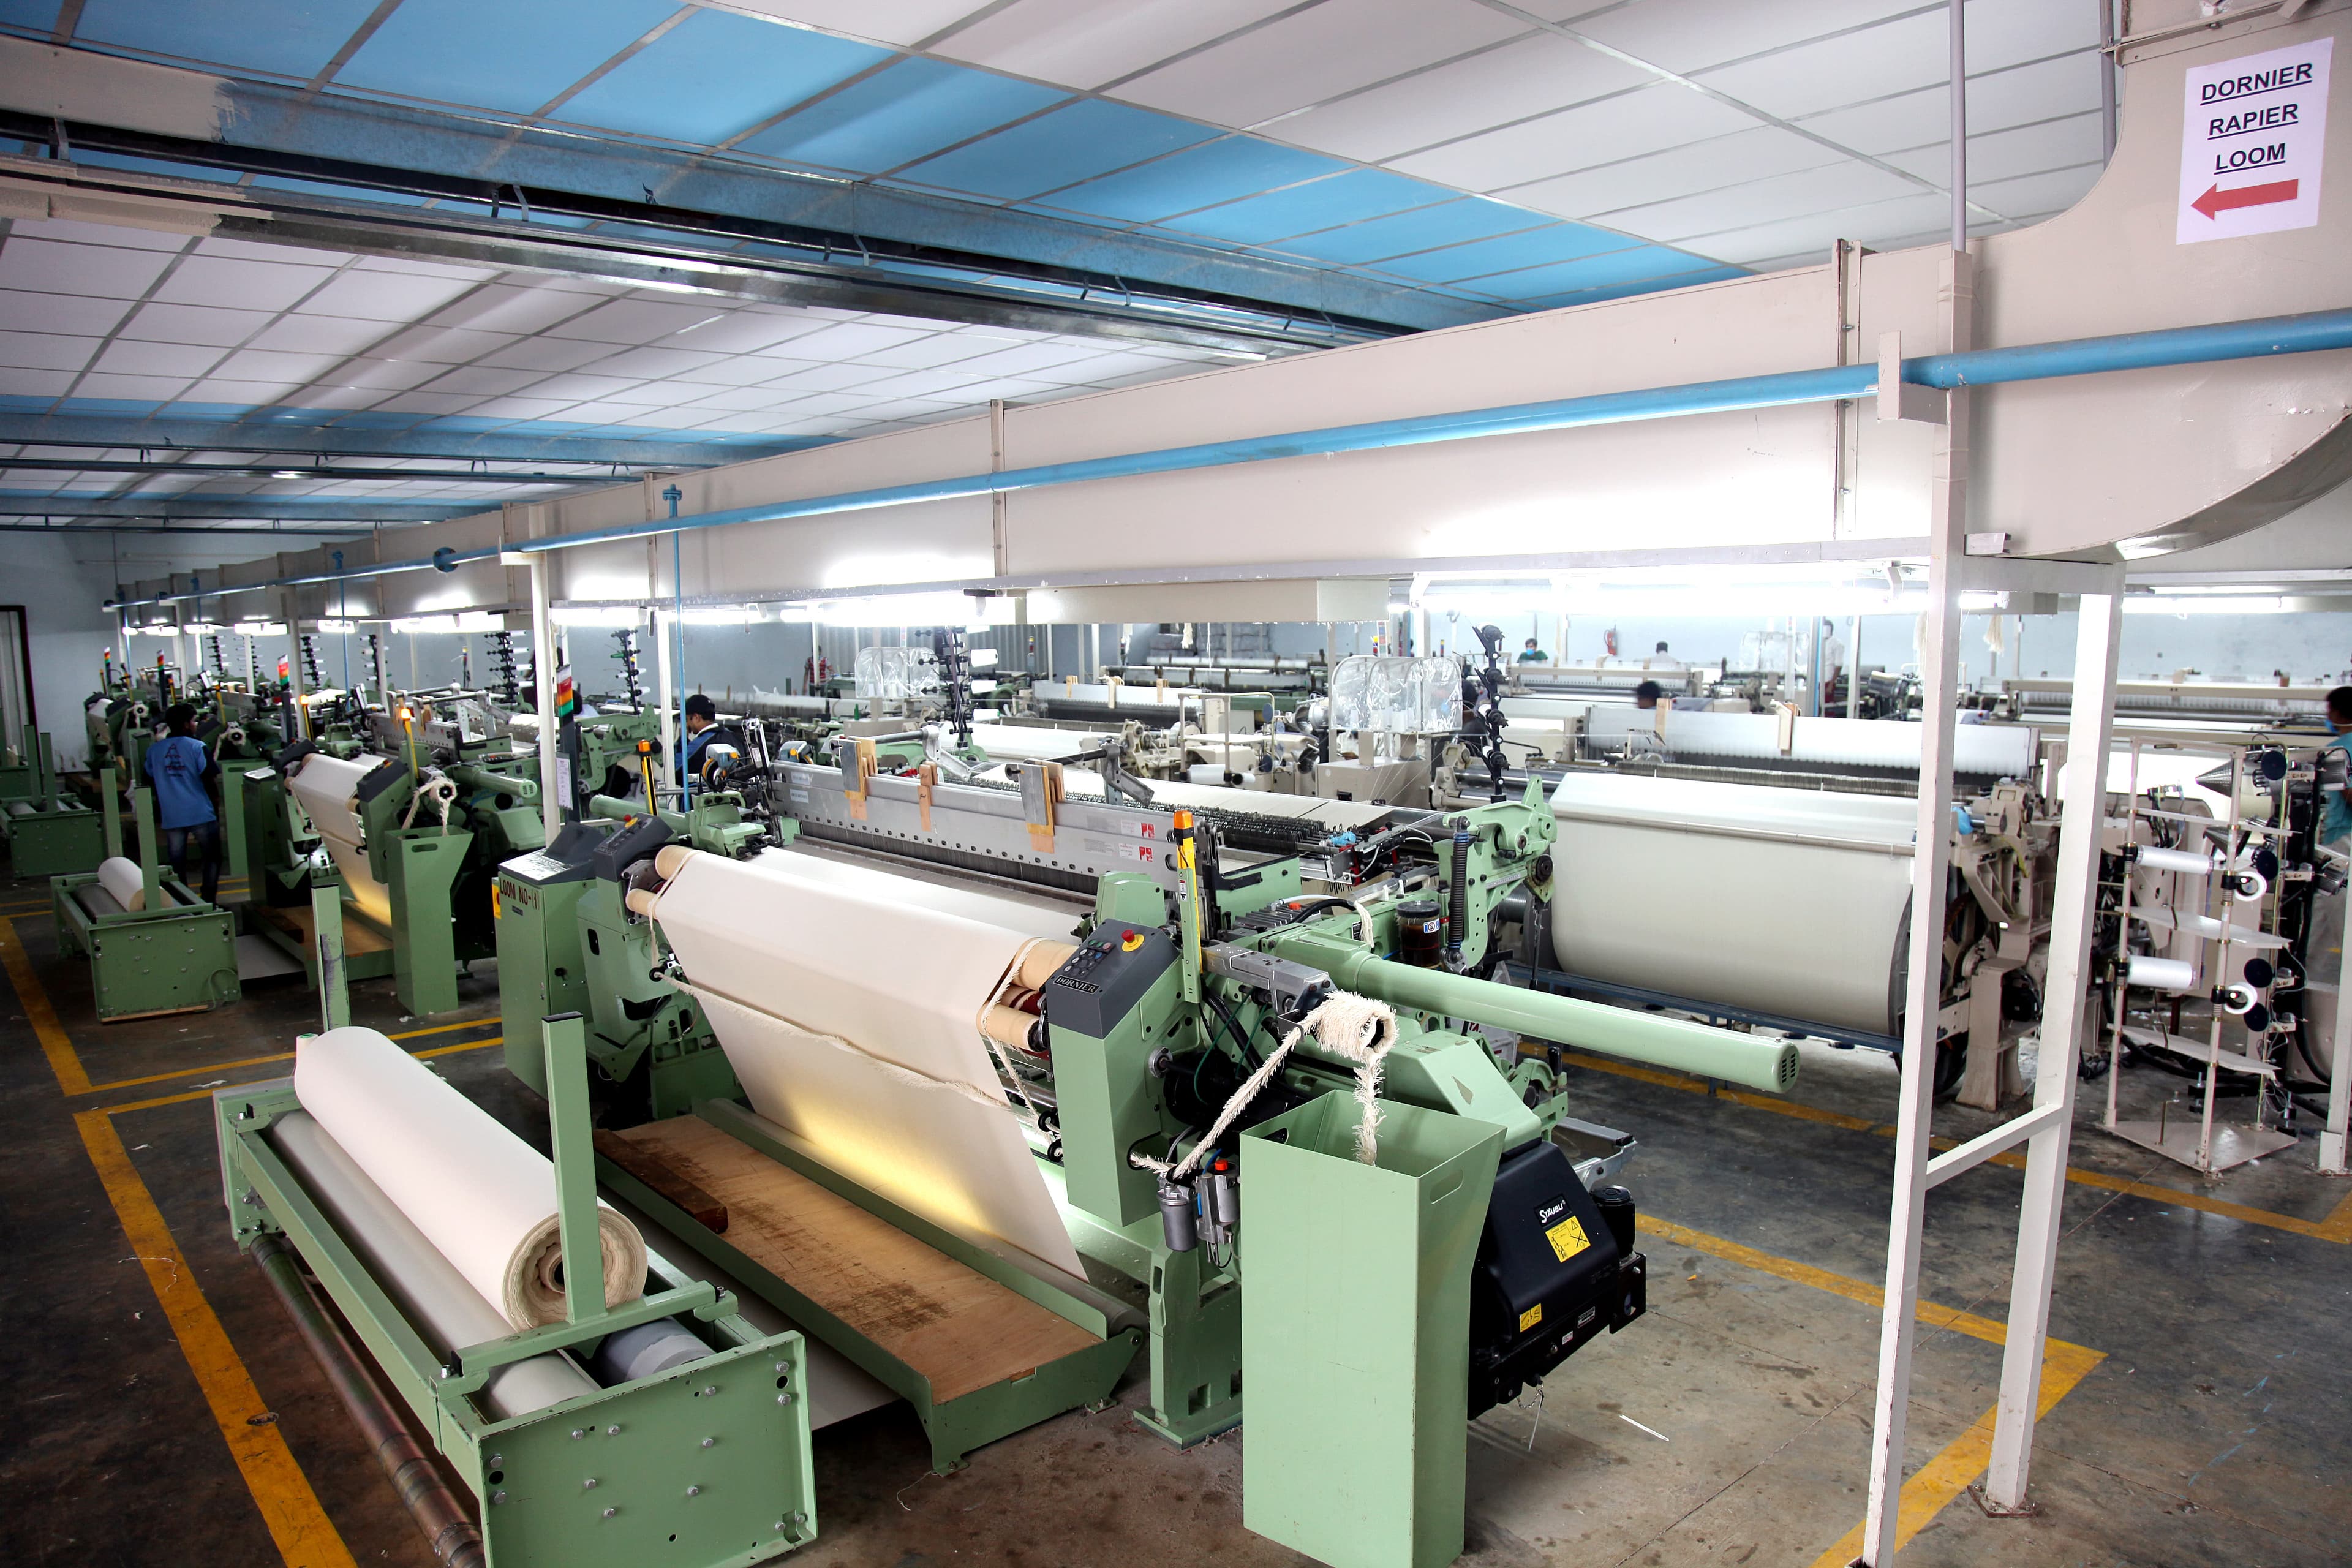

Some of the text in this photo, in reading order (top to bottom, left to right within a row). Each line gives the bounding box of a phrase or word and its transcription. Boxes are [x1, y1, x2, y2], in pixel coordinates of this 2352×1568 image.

[2201, 62, 2313, 102] DORNIER
[2208, 103, 2299, 136] RAPIER
[2215, 142, 2286, 171] LOOM
[499, 877, 516, 900] LOOM
[1055, 976, 1097, 993] DORNIER
